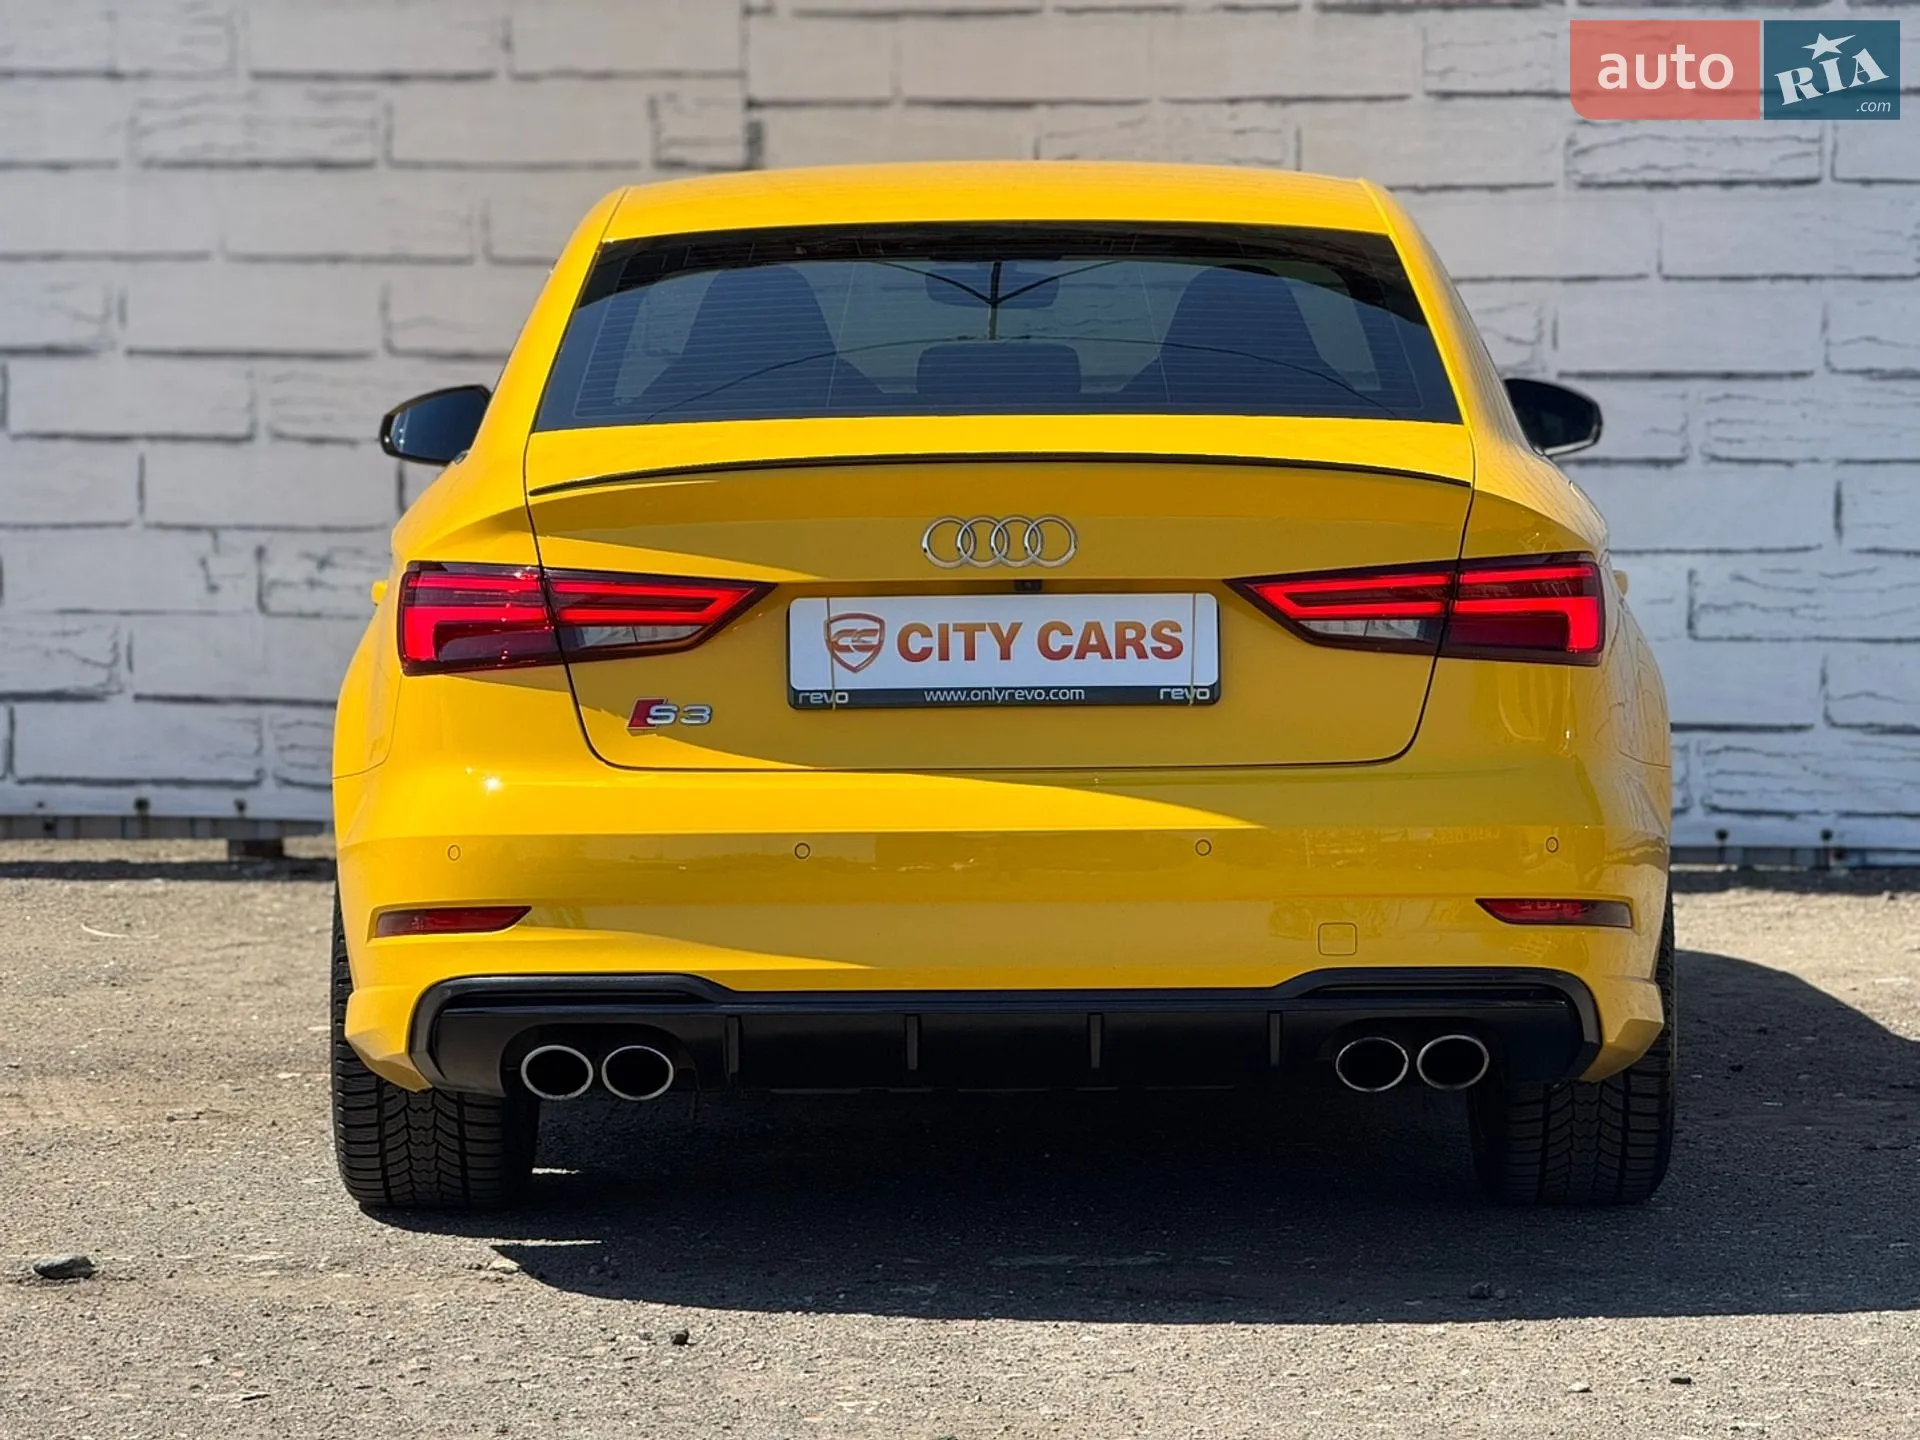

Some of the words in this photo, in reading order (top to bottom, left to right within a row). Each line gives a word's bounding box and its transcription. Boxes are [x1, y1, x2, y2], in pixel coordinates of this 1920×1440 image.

[896, 621, 1023, 663] CITY
[1037, 619, 1184, 661] CARS
[798, 691, 849, 705] revo
[924, 687, 1085, 704] www.onlyrevo.com
[1159, 686, 1210, 701] revo
[646, 703, 713, 726] S3
